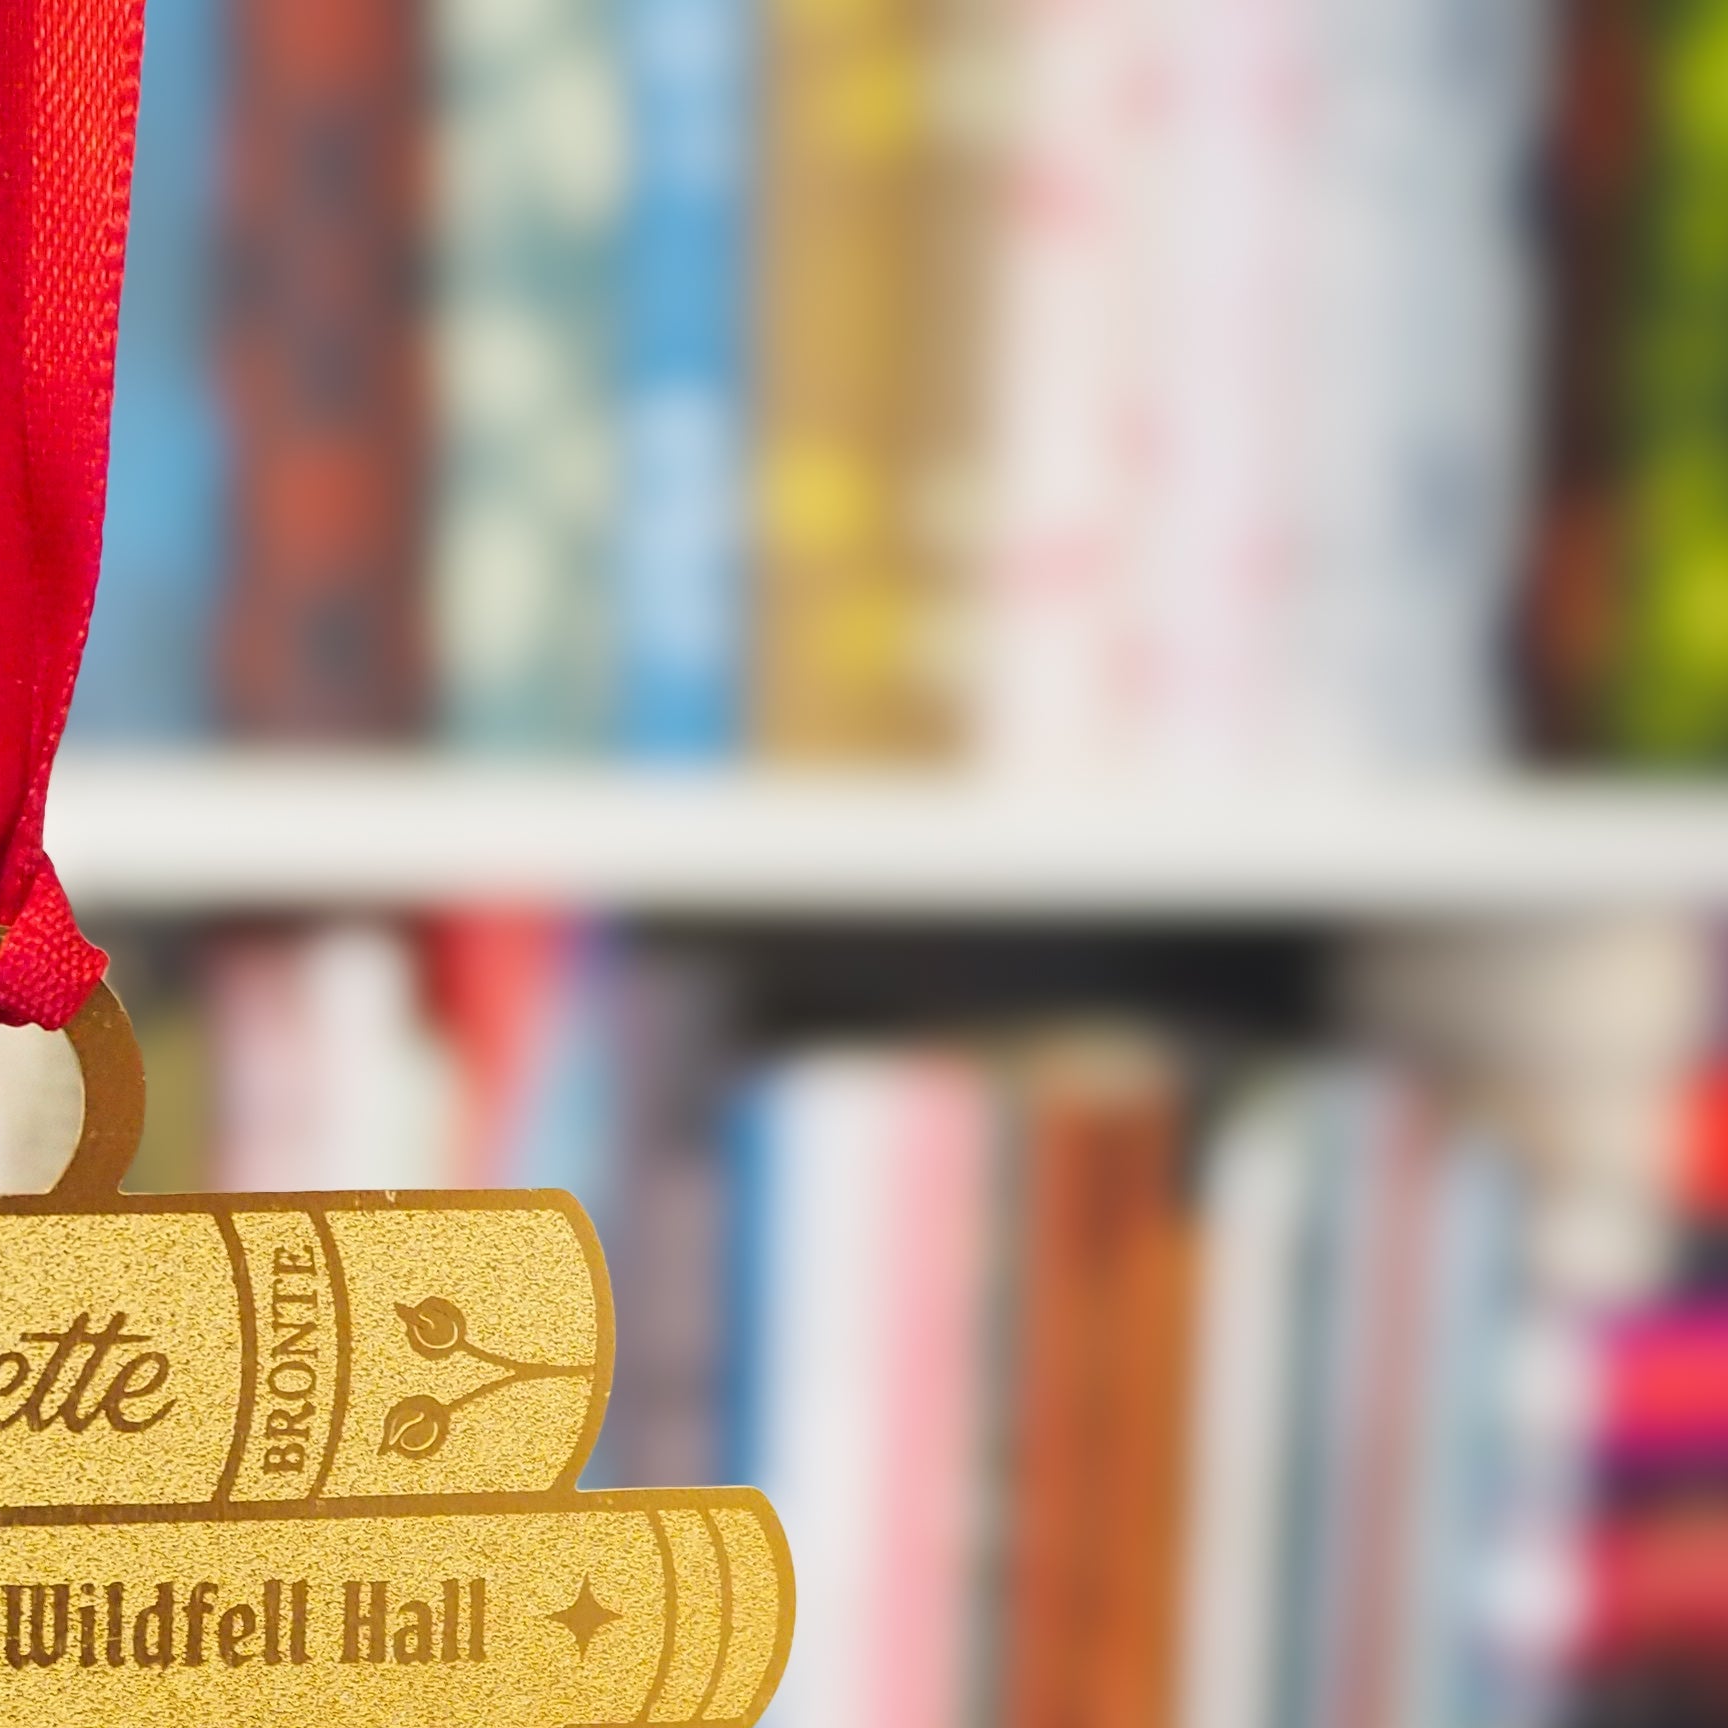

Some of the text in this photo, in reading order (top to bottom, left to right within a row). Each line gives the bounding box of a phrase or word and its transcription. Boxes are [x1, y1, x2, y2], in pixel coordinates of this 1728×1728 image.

[262, 1244, 318, 1475] BRONTE
[2, 1579, 311, 1668] Wildfell
[336, 1576, 489, 1665] Hall
